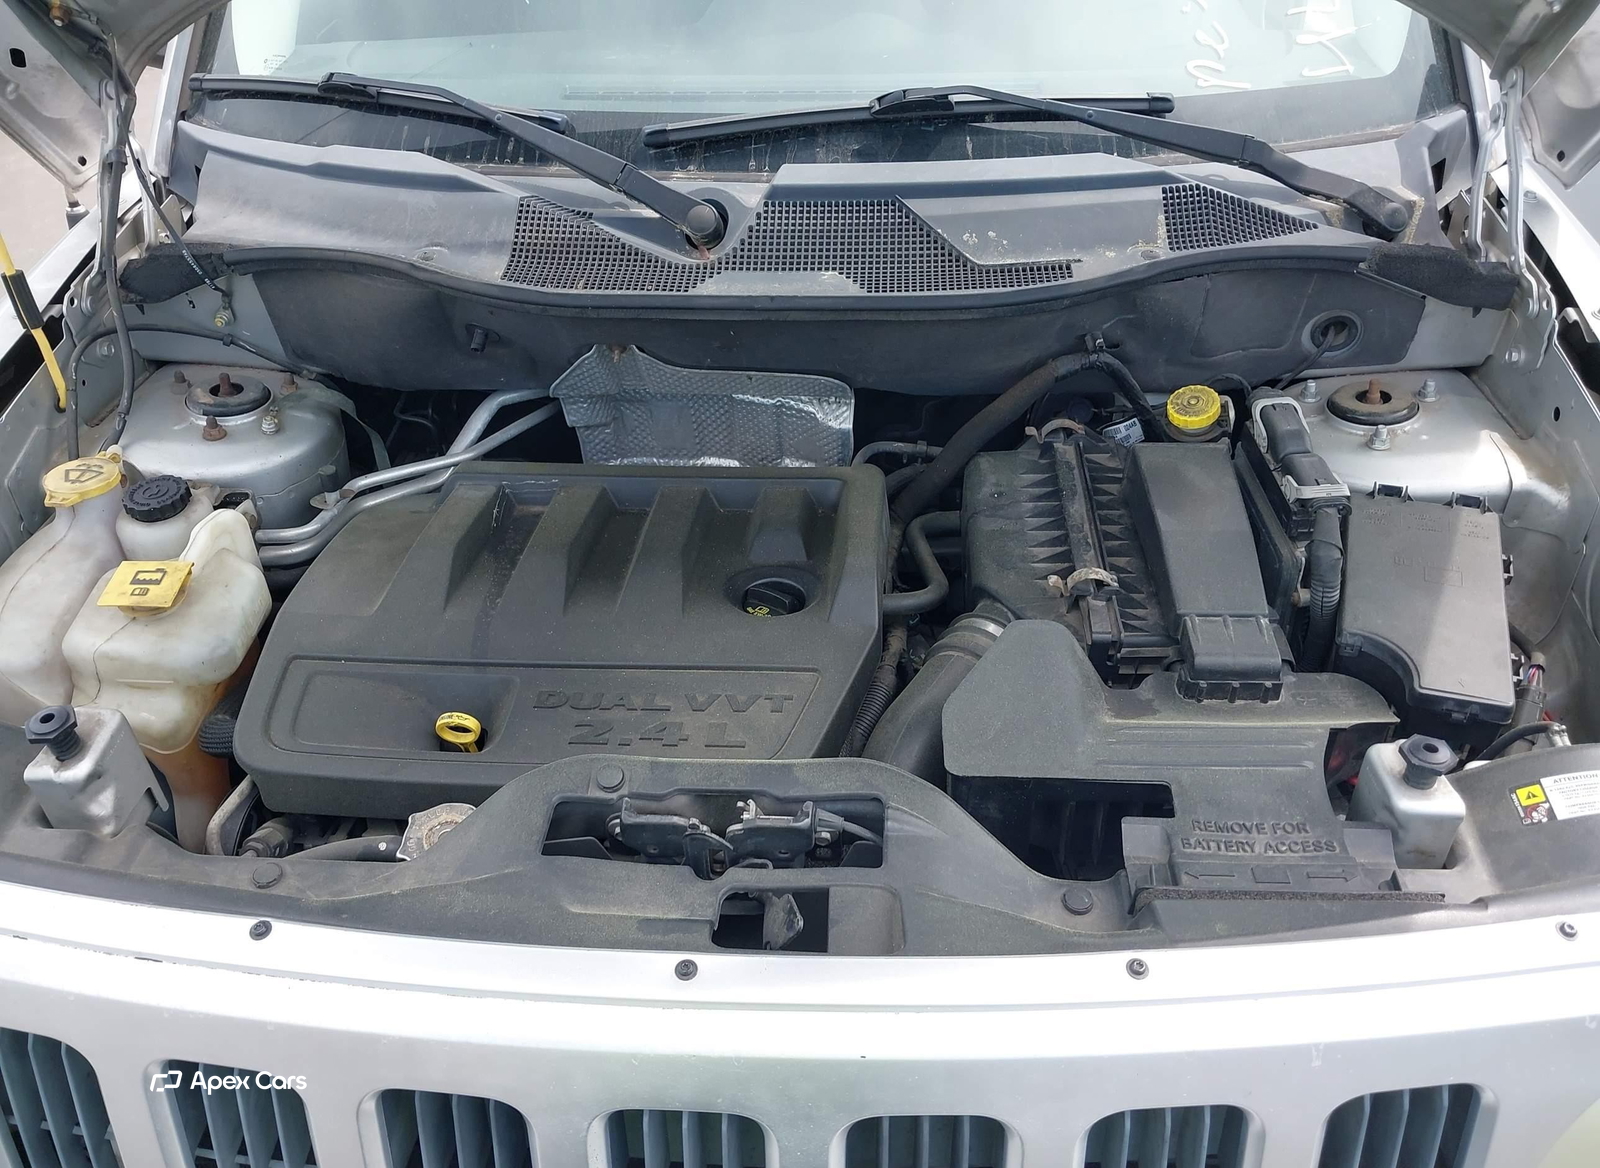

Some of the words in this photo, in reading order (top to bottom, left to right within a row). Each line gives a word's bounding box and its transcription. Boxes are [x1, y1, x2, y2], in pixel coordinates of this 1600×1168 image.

[532, 690, 671, 712] DUAL
[684, 693, 794, 713] VVT
[1553, 773, 1598, 784] ATTENTION
[1191, 819, 1268, 835] REMOVE
[1271, 821, 1311, 834] FOR
[1181, 837, 1257, 854] BATTERY
[1263, 839, 1338, 855] ACCESS
